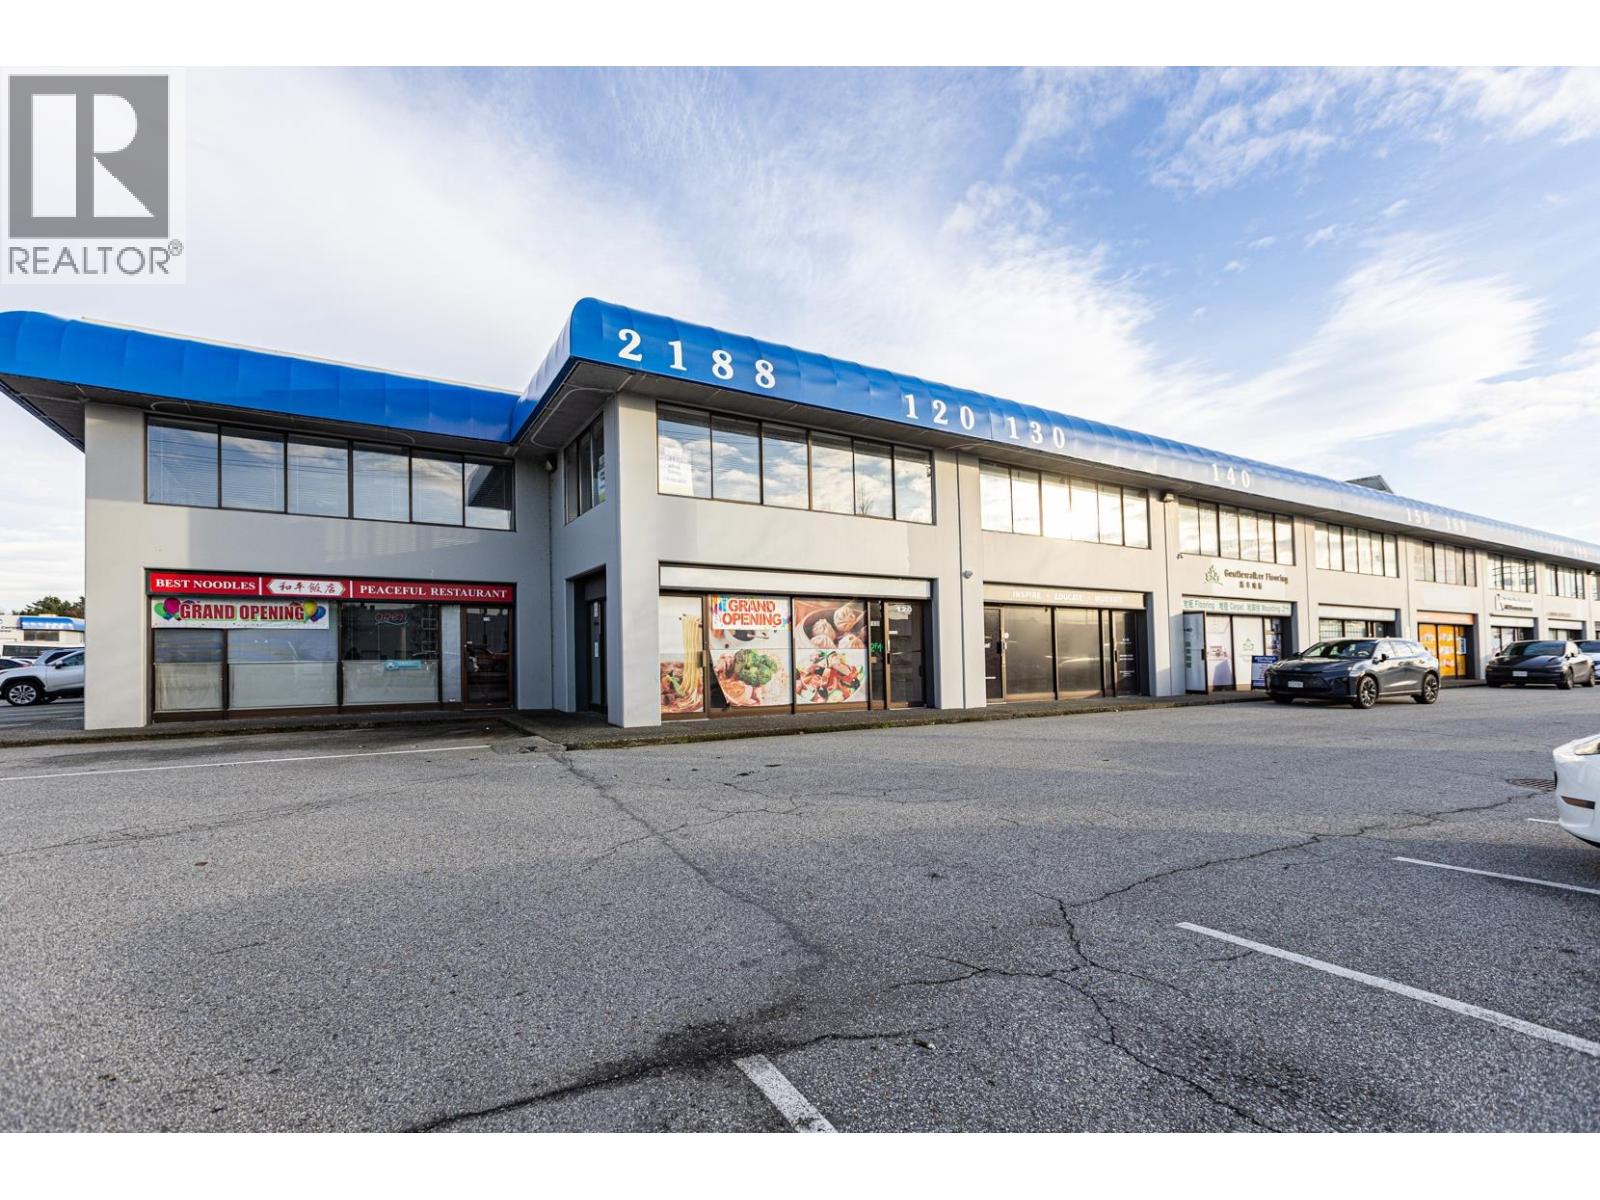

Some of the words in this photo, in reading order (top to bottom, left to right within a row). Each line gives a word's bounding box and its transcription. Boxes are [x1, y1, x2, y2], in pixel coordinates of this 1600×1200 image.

[617, 328, 777, 390] 2188
[904, 394, 976, 431] 120
[1006, 416, 1066, 450] 130
[1211, 463, 1251, 488] 140
[155, 578, 190, 589] BEST
[193, 579, 256, 591] NOODLES
[360, 584, 427, 596] PEACEFUL
[430, 587, 507, 599] RESTAURANT
[179, 603, 236, 620] GRAND
[239, 604, 305, 621] OPENING
[728, 599, 776, 613] GRAND
[722, 613, 782, 627] OPENING
